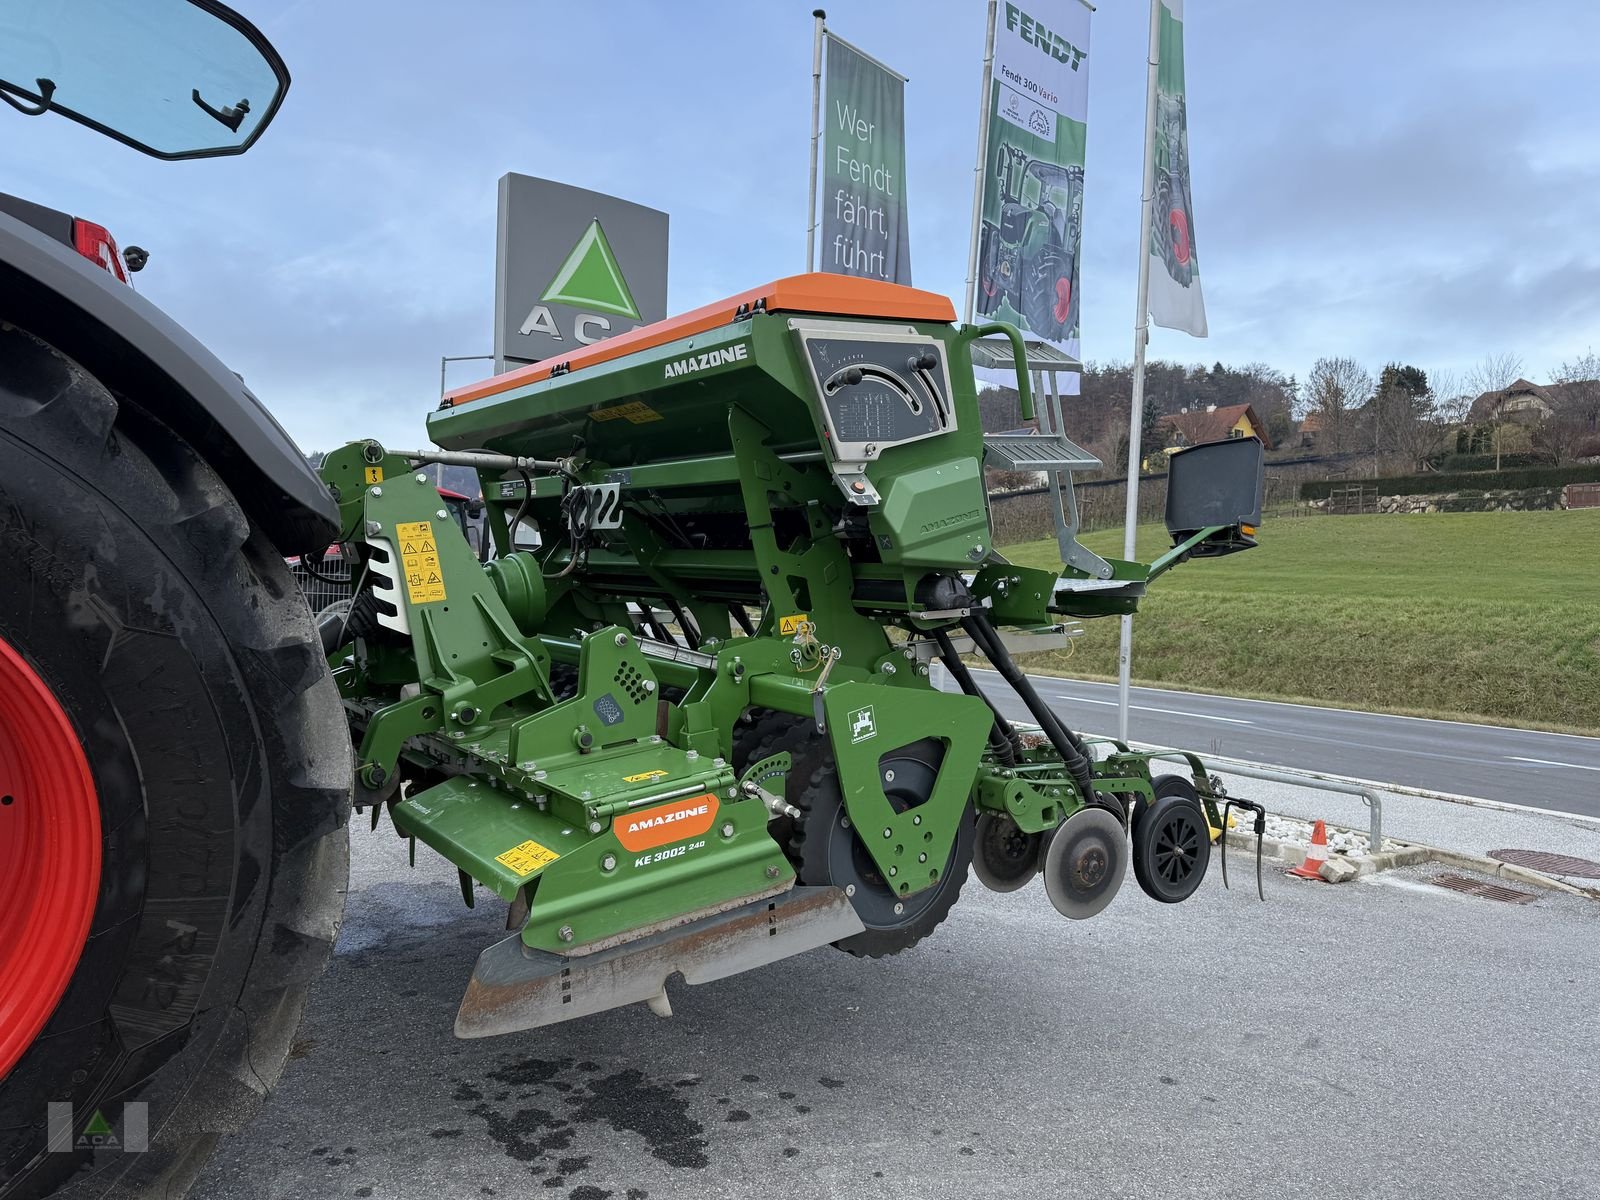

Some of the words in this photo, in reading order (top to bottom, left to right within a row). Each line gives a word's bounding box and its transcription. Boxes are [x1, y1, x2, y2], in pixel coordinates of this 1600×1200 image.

[1005, 1, 1087, 72] FENDT
[1001, 65, 1021, 85] Fendt
[1023, 78, 1038, 93] 300
[1038, 85, 1058, 104] Vario
[836, 100, 875, 144] Wer
[837, 145, 893, 195] Fendt
[835, 190, 888, 240] fährt,
[833, 234, 889, 279] führt.
[518, 304, 644, 346] AC
[664, 343, 748, 379] AMAZONE
[919, 509, 981, 534] AMAZONE
[627, 804, 709, 833] AMAZONE
[634, 854, 651, 868] KE
[654, 846, 686, 863] 3002
[688, 840, 706, 851] 240
